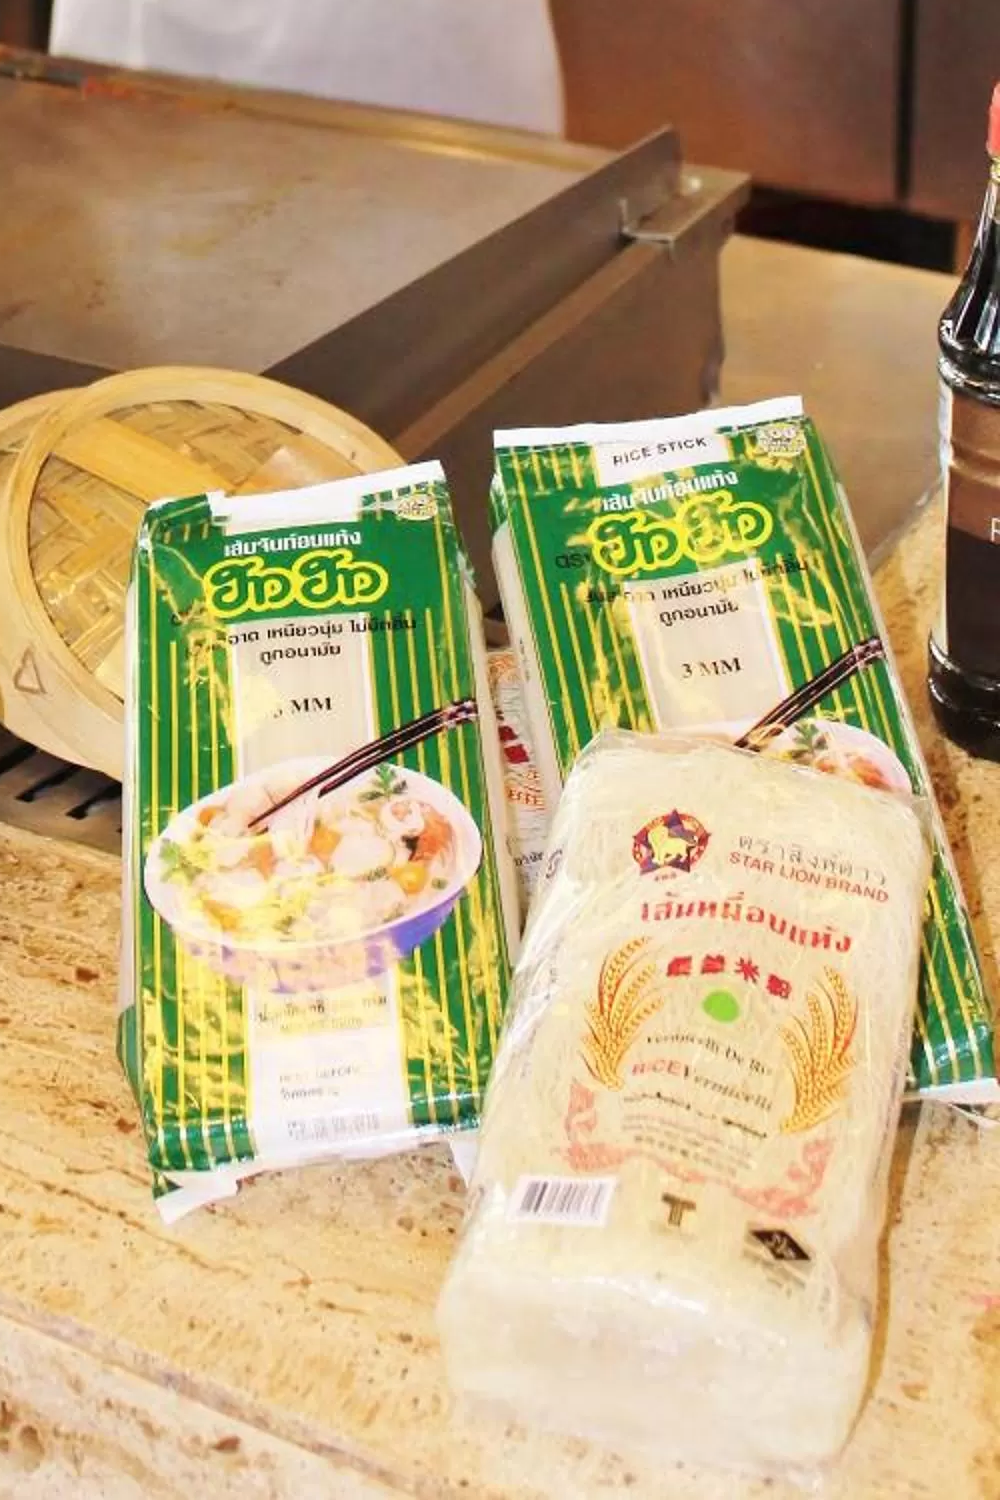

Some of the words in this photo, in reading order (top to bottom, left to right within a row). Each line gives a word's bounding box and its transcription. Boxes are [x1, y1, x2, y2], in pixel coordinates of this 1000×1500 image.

[613, 446, 652, 466] RICE
[657, 437, 707, 454] STICK
[682, 663, 692, 678] 3
[699, 657, 741, 676] MM
[289, 696, 332, 714] MM
[729, 851, 775, 874] STAR
[779, 864, 821, 886] LION
[826, 876, 889, 903] BRAND
